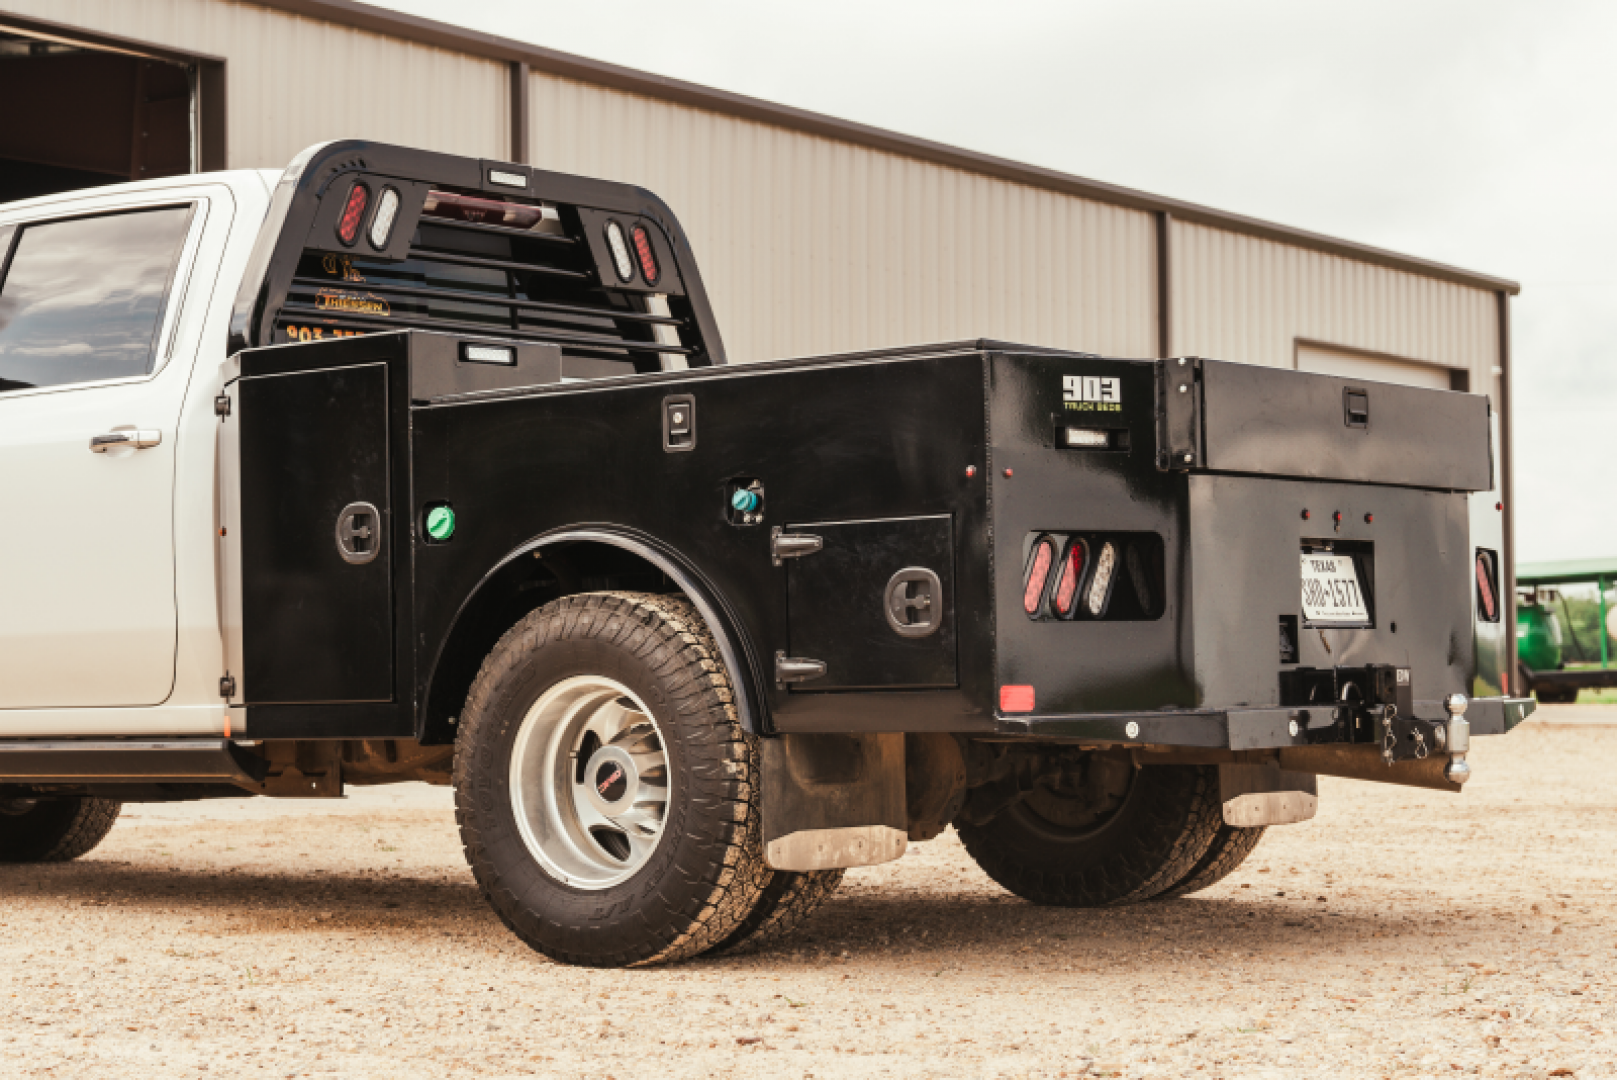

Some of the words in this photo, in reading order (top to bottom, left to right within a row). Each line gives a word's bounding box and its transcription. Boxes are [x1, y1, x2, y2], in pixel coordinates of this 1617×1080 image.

[1062, 375, 1121, 403] 903
[1063, 402, 1094, 411] TRUCK
[1309, 559, 1337, 573] TEXAS
